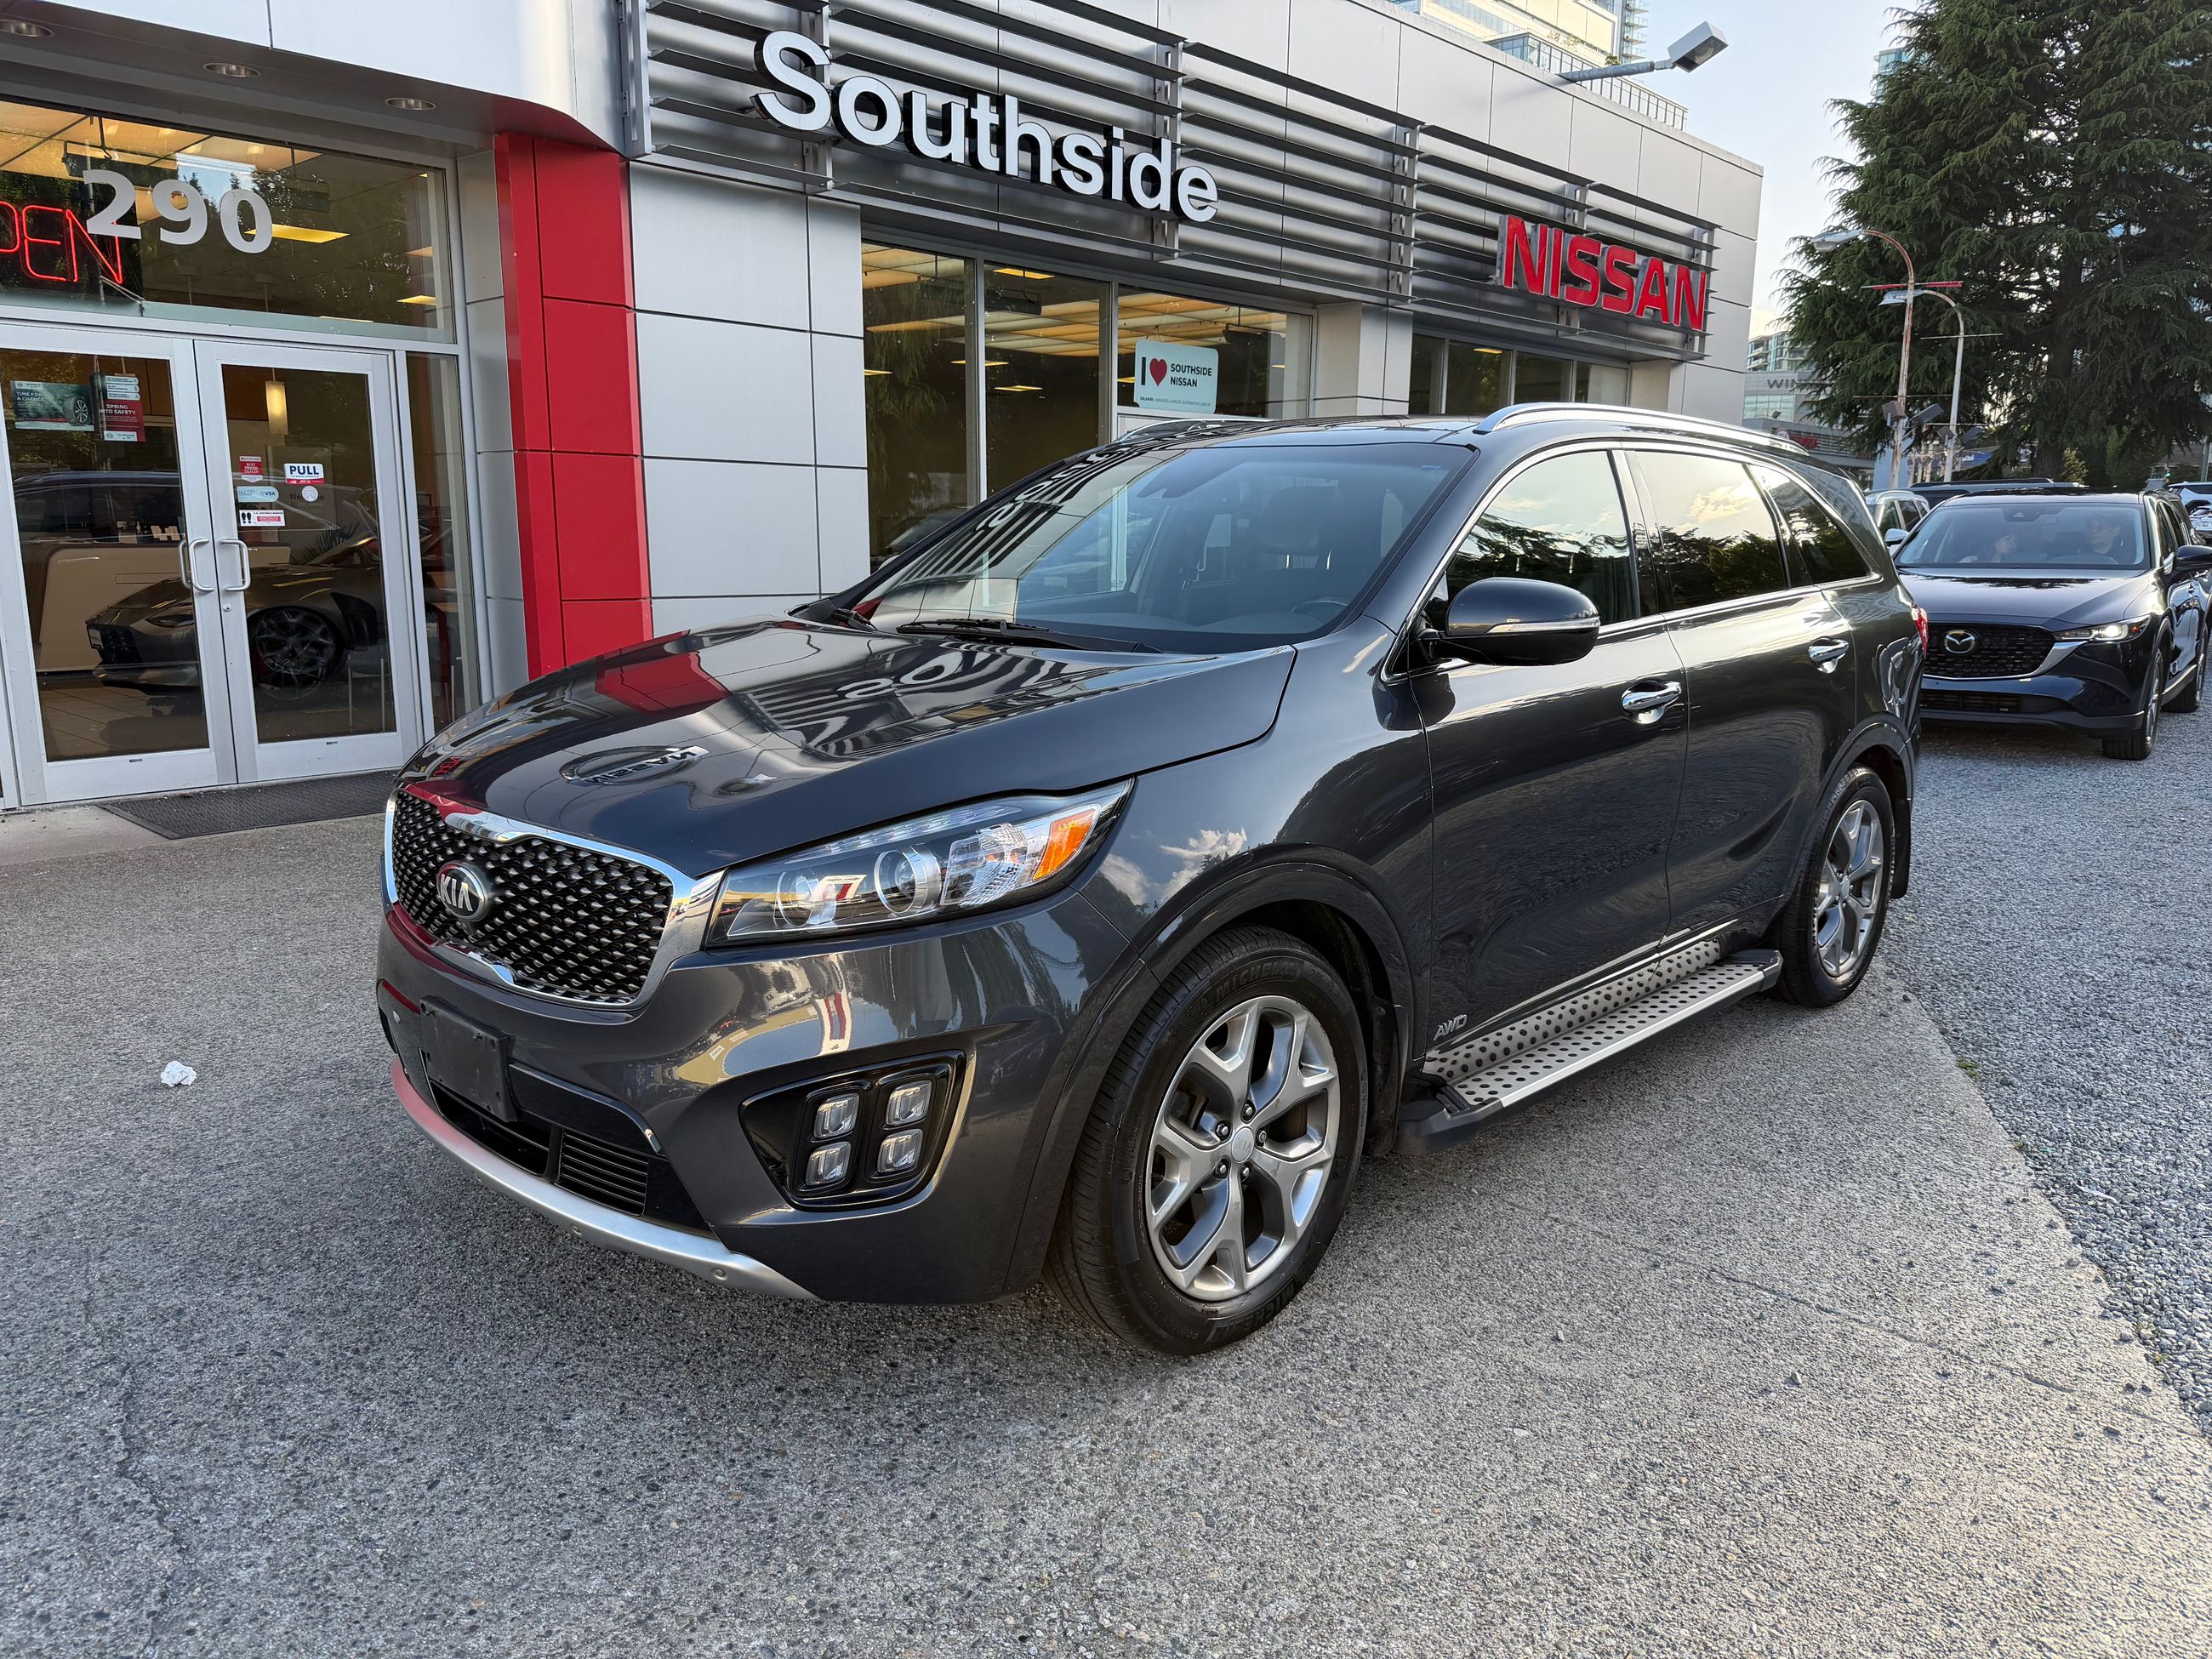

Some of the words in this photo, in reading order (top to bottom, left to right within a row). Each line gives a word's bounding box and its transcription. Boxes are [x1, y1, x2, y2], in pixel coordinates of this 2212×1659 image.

[750, 30, 1218, 222] Southside
[83, 169, 272, 254] 290
[1497, 214, 1707, 331] NISSAN
[1141, 356, 1146, 385] I
[1170, 376, 1198, 387] NISSAN
[1171, 363, 1212, 376] SOUTHSIDE
[289, 465, 319, 475] PULL
[440, 873, 473, 912] KIA
[1433, 1014, 1468, 1041] AWD
